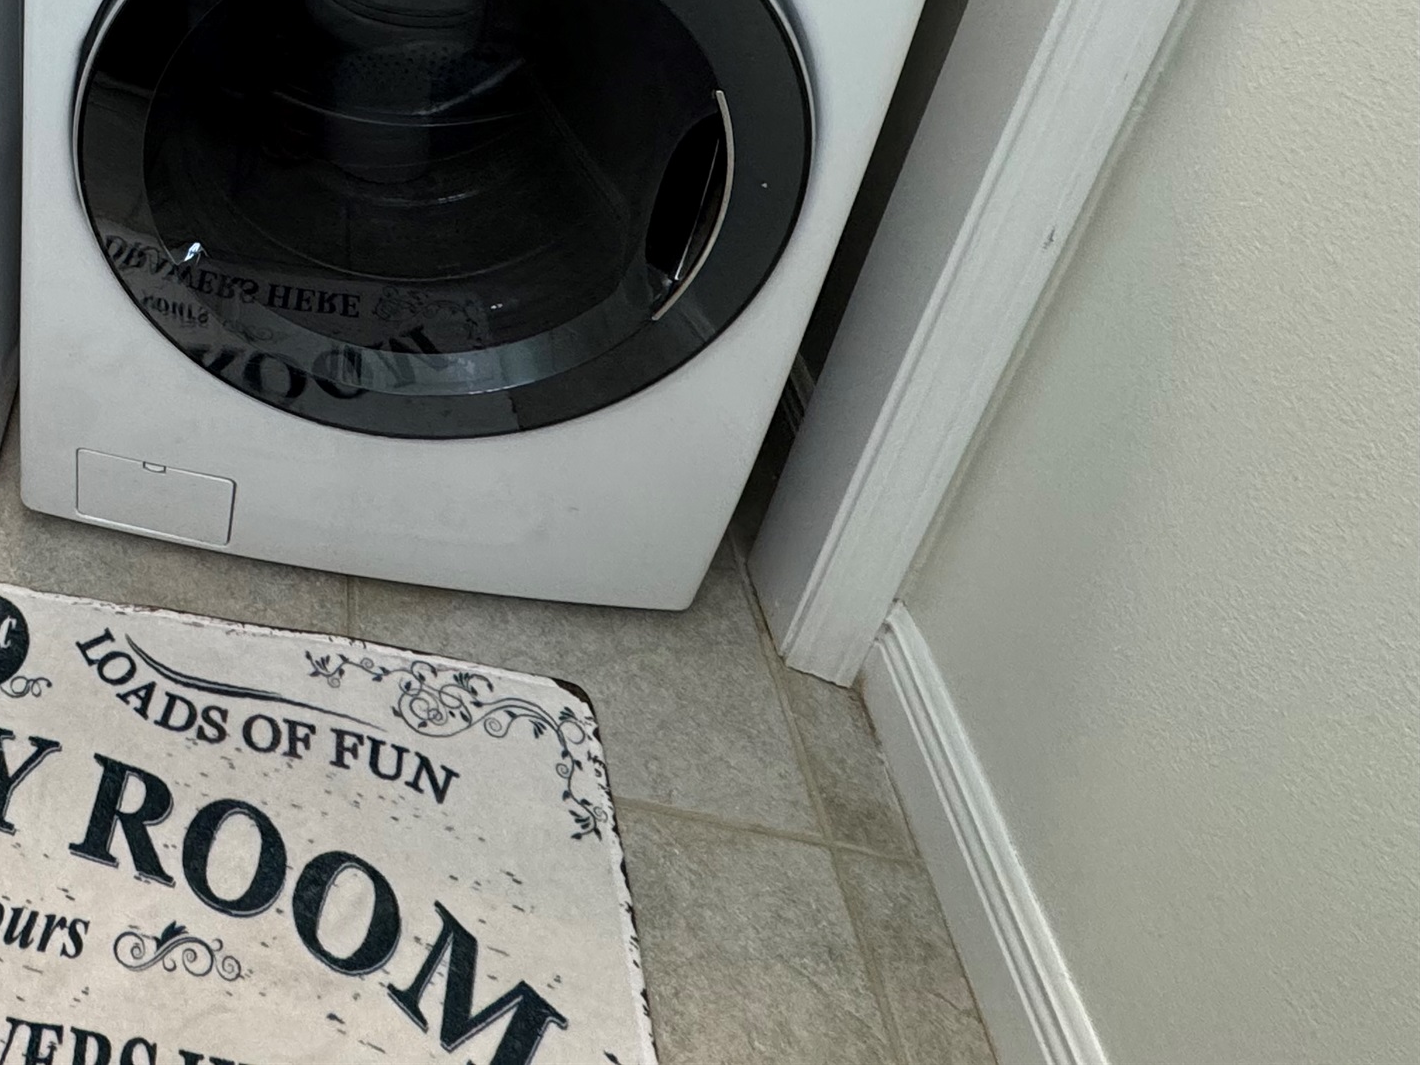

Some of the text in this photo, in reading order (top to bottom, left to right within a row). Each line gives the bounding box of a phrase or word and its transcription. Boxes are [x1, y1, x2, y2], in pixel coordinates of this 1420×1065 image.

[75, 626, 461, 805] LOADS OF FUN
[67, 753, 570, 1065] ROOM
